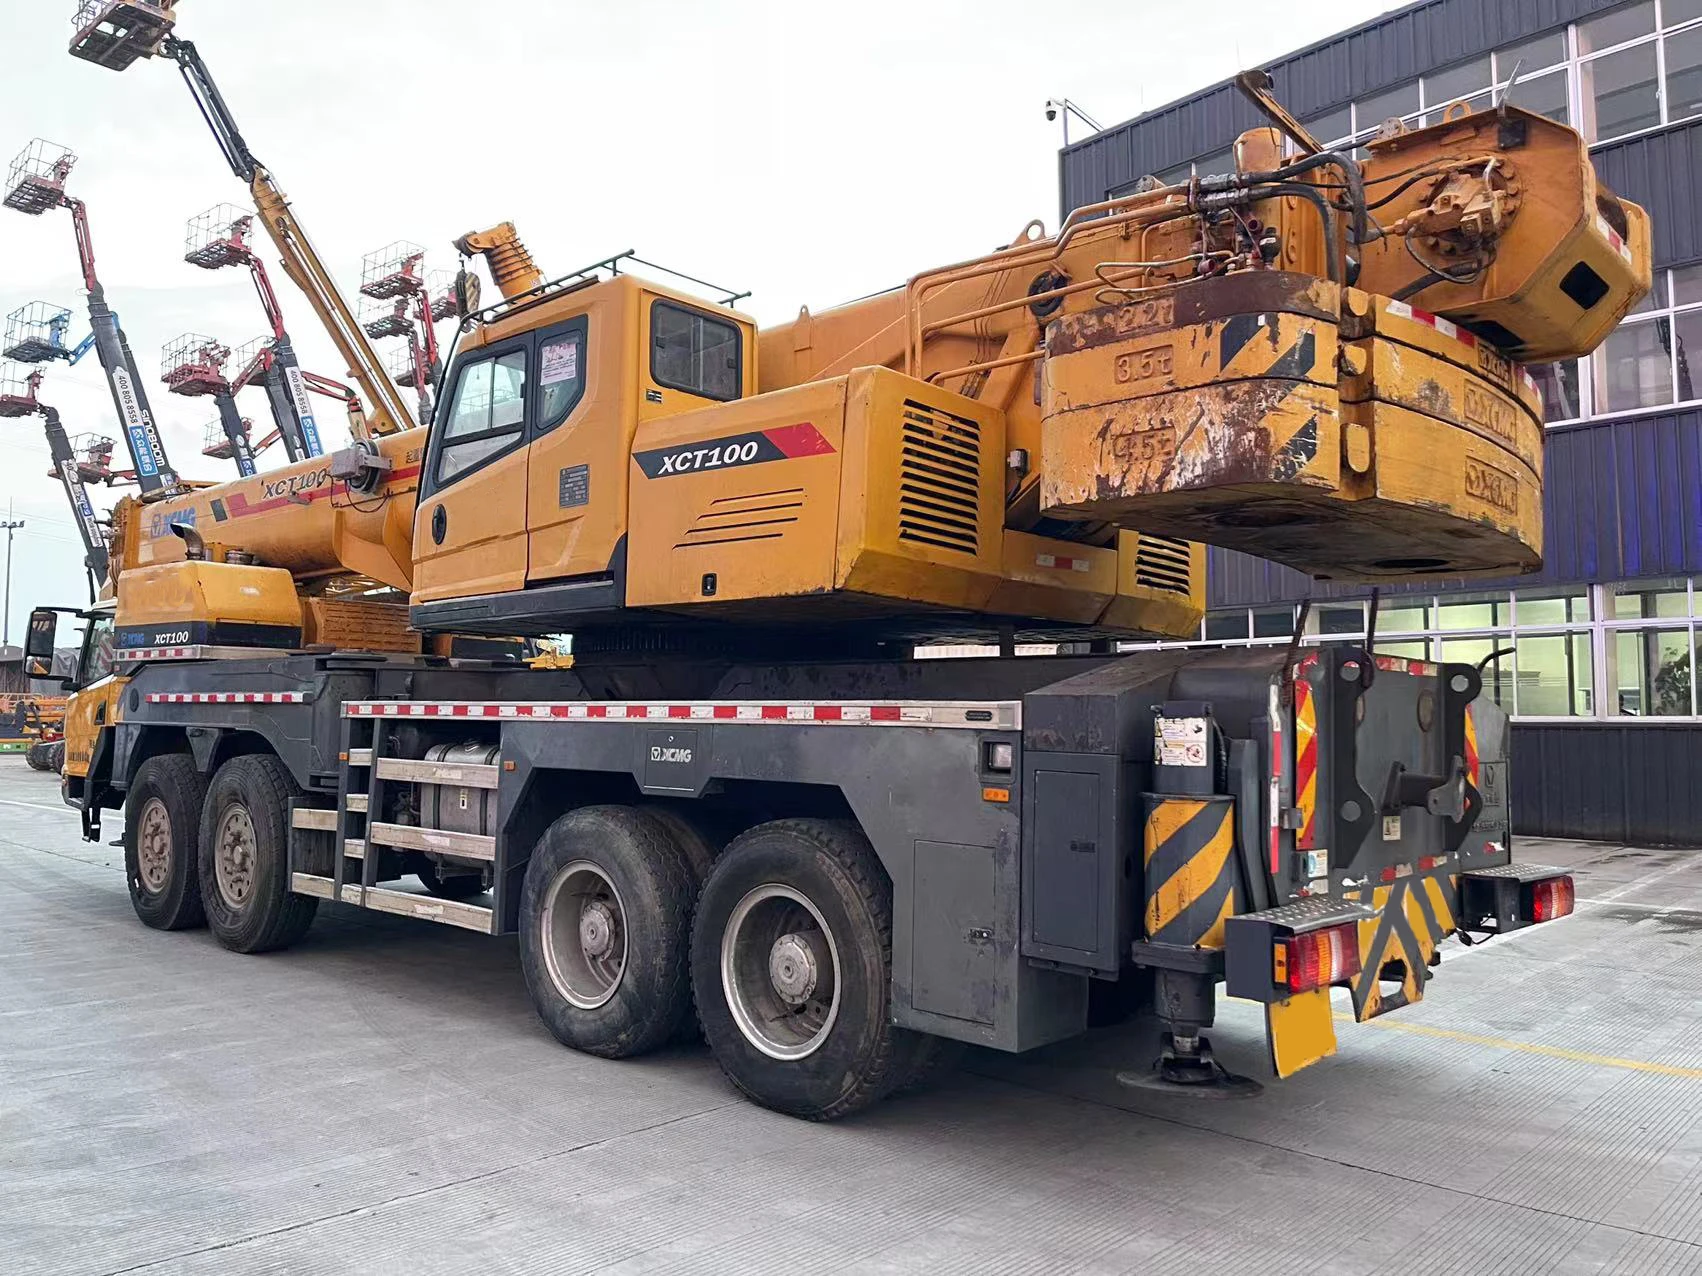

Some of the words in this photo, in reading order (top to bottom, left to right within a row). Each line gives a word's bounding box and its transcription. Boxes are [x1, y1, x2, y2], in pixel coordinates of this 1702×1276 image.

[1118, 351, 1172, 382] 3.5t
[118, 375, 128, 390] 400
[290, 370, 299, 384] 400
[122, 390, 133, 404] 805
[126, 404, 139, 424] 8558
[658, 441, 758, 475] XCT100
[263, 468, 327, 499] XCT100
[154, 631, 189, 645] XCT100
[661, 747, 692, 763] XCMG
